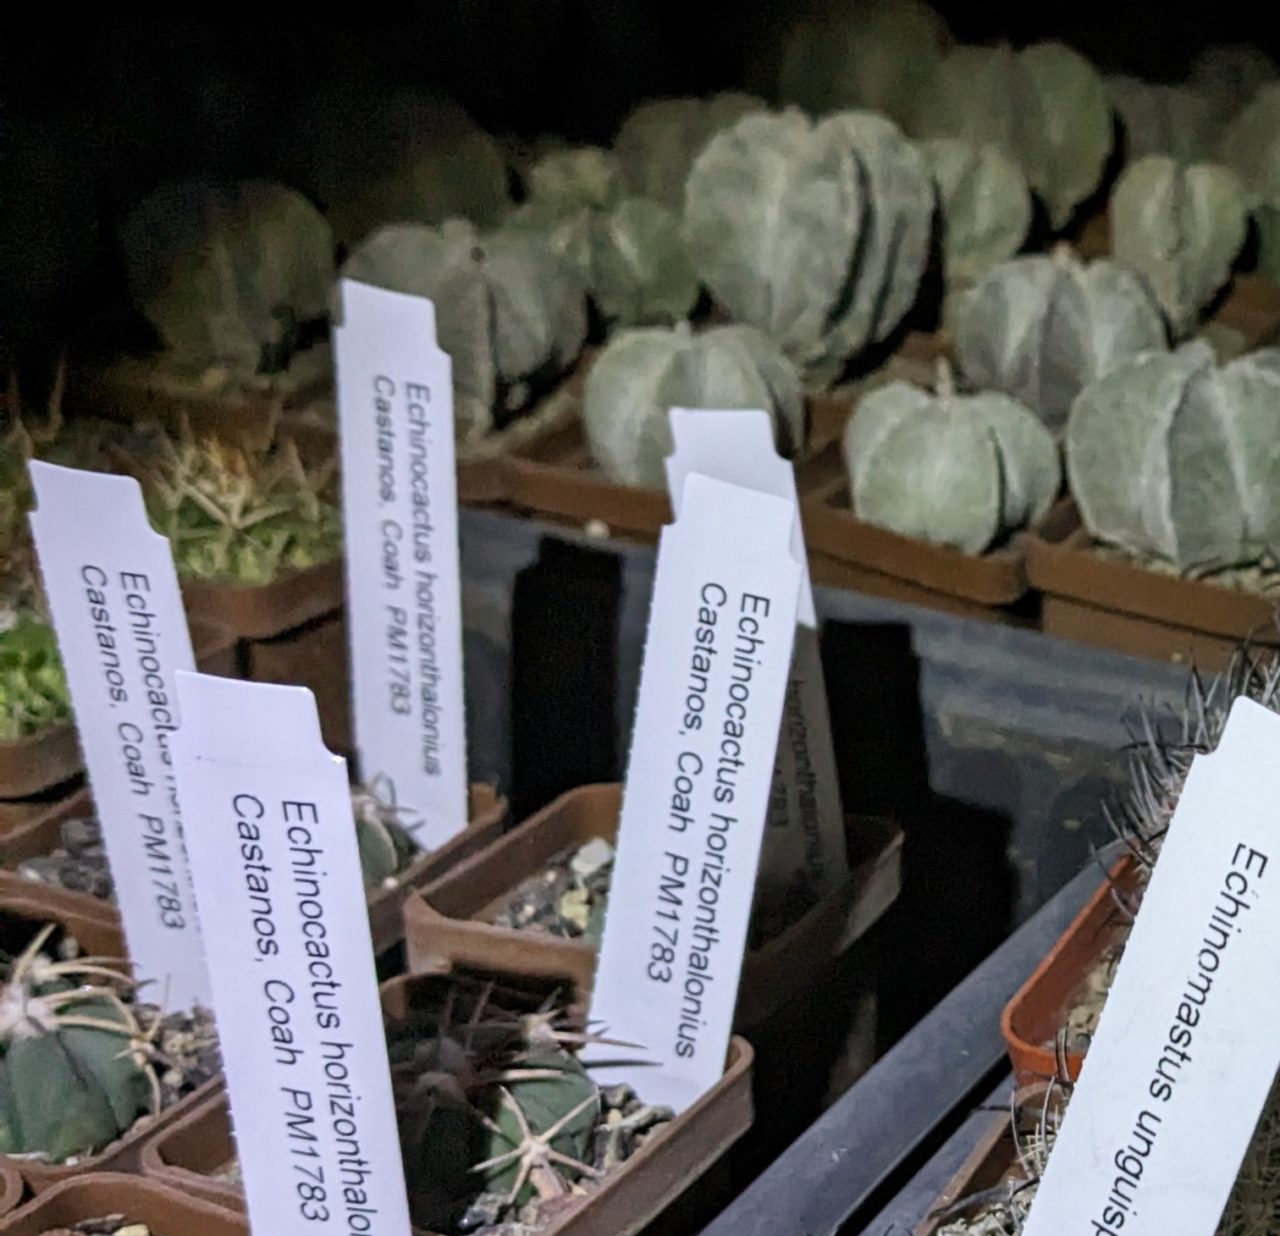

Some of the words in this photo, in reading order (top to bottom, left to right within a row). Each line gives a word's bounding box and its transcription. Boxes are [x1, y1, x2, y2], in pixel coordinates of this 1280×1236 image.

[382, 519, 406, 590] Coah
[405, 381, 435, 564] Echinocactus
[386, 604, 413, 716] PM1783
[415, 571, 445, 777] horizonthalonius
[678, 582, 728, 737] Castanos,
[713, 592, 771, 804] Echinocactus
[81, 564, 128, 708] Castanos,
[117, 722, 154, 796] Coah
[138, 812, 186, 930] PM1783
[668, 751, 703, 833] Coah
[233, 793, 279, 962] Castanos,
[282, 800, 342, 1030] Echinocactus
[647, 851, 689, 984] PM1783
[675, 812, 738, 1059] horizonthalonius
[264, 979, 304, 1066] Coah
[1149, 842, 1269, 1103] Echinomastus
[281, 1087, 330, 1223] PM1783
